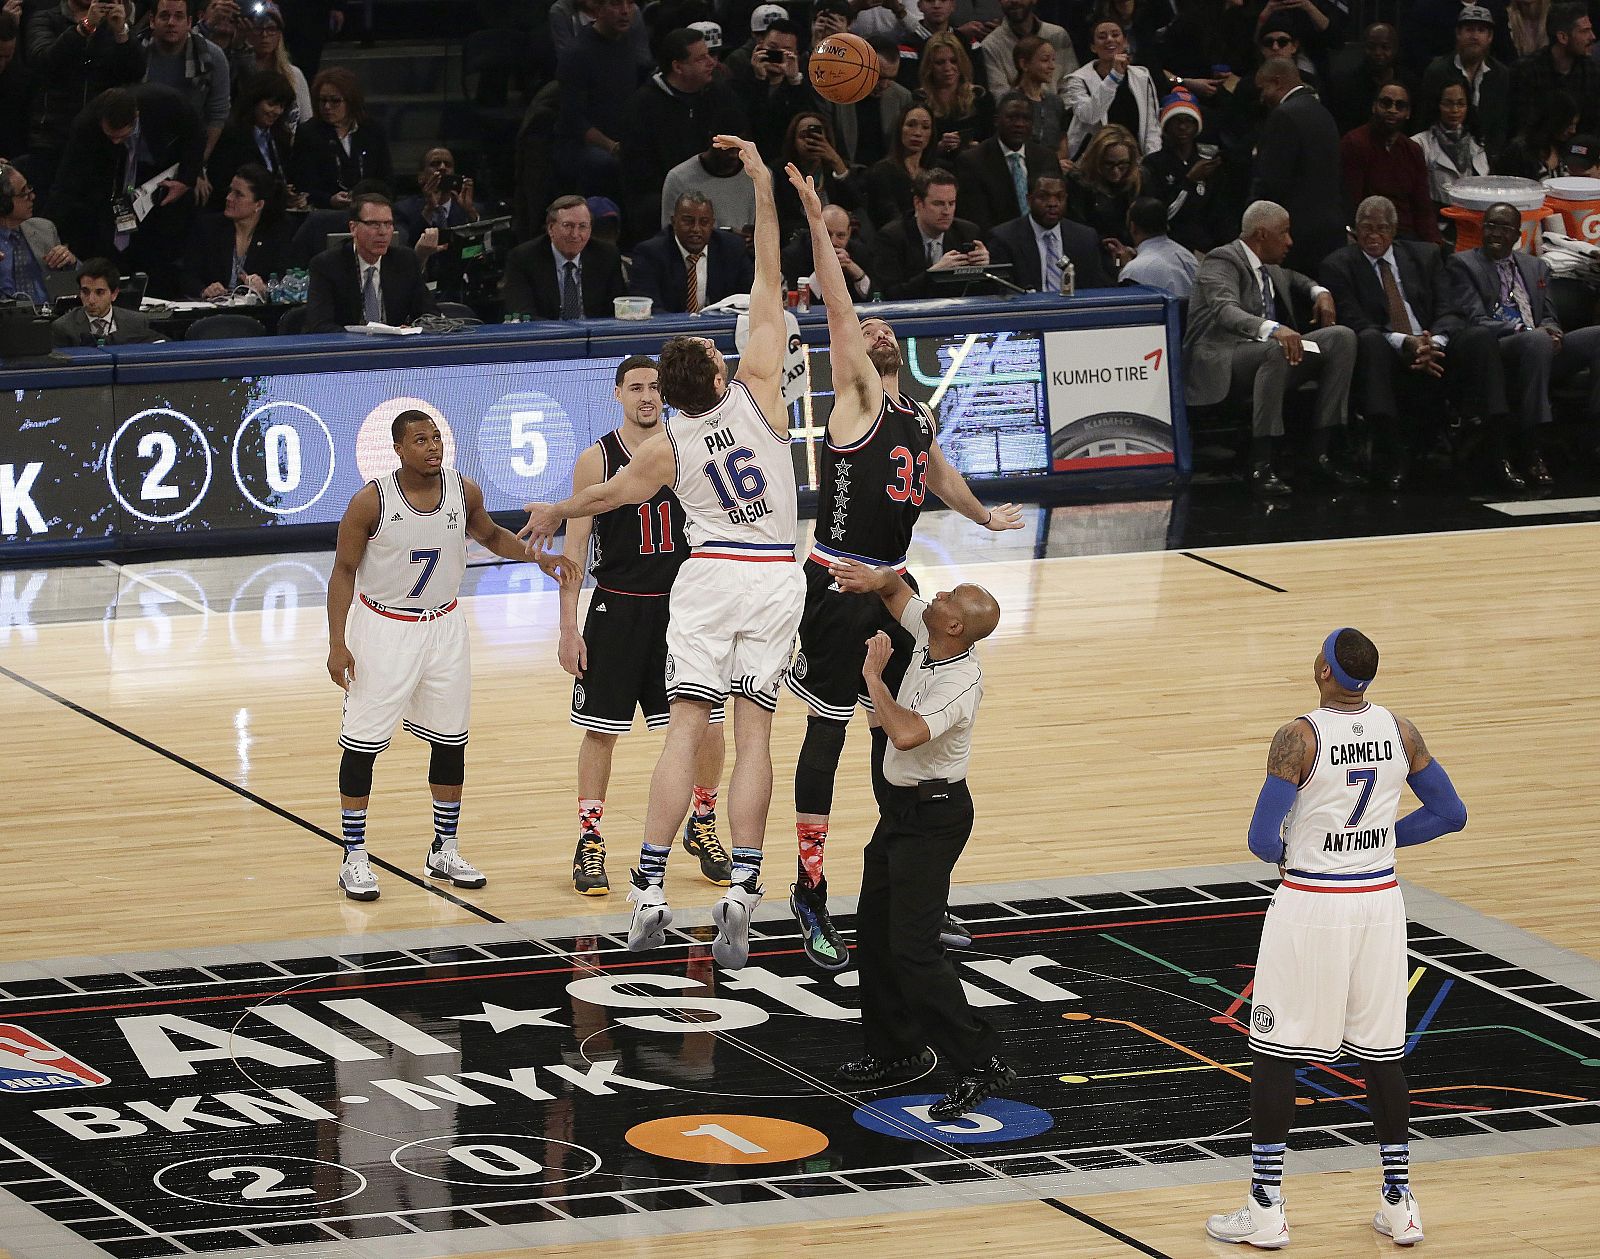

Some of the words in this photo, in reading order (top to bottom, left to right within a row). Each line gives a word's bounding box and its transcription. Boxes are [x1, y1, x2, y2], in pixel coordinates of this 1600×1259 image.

[1053, 368, 1112, 386] KUMHO
[1115, 366, 1149, 381] TIRE
[704, 427, 736, 455] PAU
[1083, 416, 1134, 430] KUMHO
[137, 431, 180, 500] 2
[264, 424, 301, 493] 0
[509, 410, 549, 478] 5
[703, 446, 768, 511] 16
[886, 445, 929, 506] 33
[0, 461, 49, 535] K
[728, 498, 773, 524] GASOL
[638, 501, 675, 554] 11
[406, 548, 441, 598] 7
[1330, 740, 1393, 766] CARMELO
[1344, 767, 1378, 829] 7
[1323, 828, 1389, 852] ANTHONY
[114, 997, 461, 1079] All
[565, 954, 1083, 1033] Str
[1255, 1012, 1271, 1027] EAST
[2, 1075, 75, 1089] NBA
[208, 1165, 316, 1200] 2
[447, 1144, 543, 1176] 0
[680, 1122, 770, 1155] 1
